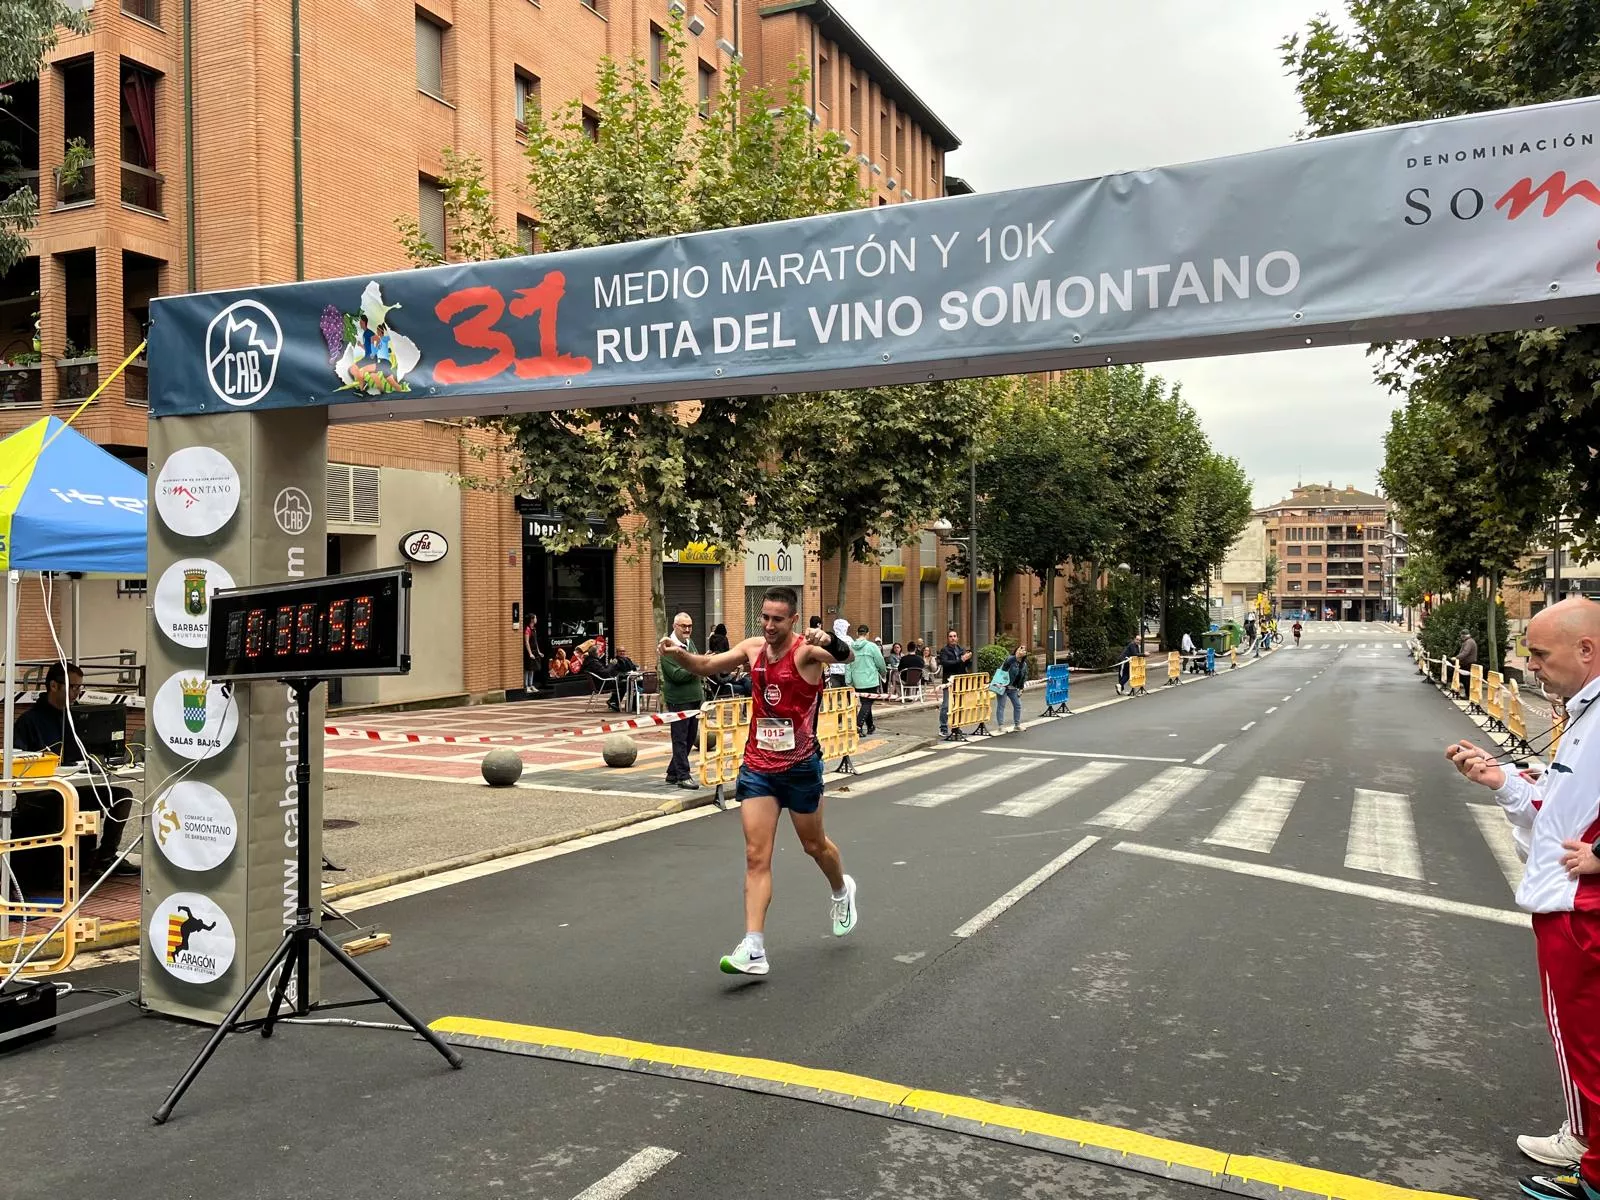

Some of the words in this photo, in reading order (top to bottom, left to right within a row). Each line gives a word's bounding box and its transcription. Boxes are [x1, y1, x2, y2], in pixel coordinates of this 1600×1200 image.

[1406, 133, 1594, 169] DENOMINACIÓN
[594, 265, 709, 309] MEDIO
[721, 233, 916, 294] MARATÓN
[930, 231, 960, 269] Y
[976, 219, 1055, 264] 10K
[597, 320, 702, 365] RUTA
[713, 311, 796, 355] DEL
[808, 295, 923, 344] VINO
[938, 250, 1301, 331] SOMONTANO
[432, 270, 593, 384] 31
[224, 350, 262, 395] CAB
[49, 488, 148, 515] ite
[284, 510, 303, 530] CAB
[245, 596, 371, 658] 0:35:52
[169, 736, 194, 746] SALAS
[197, 738, 221, 748] BAJAS
[763, 728, 785, 738] 1015
[184, 821, 231, 836] SOMONTANO
[180, 952, 216, 970] ARAGÓN
